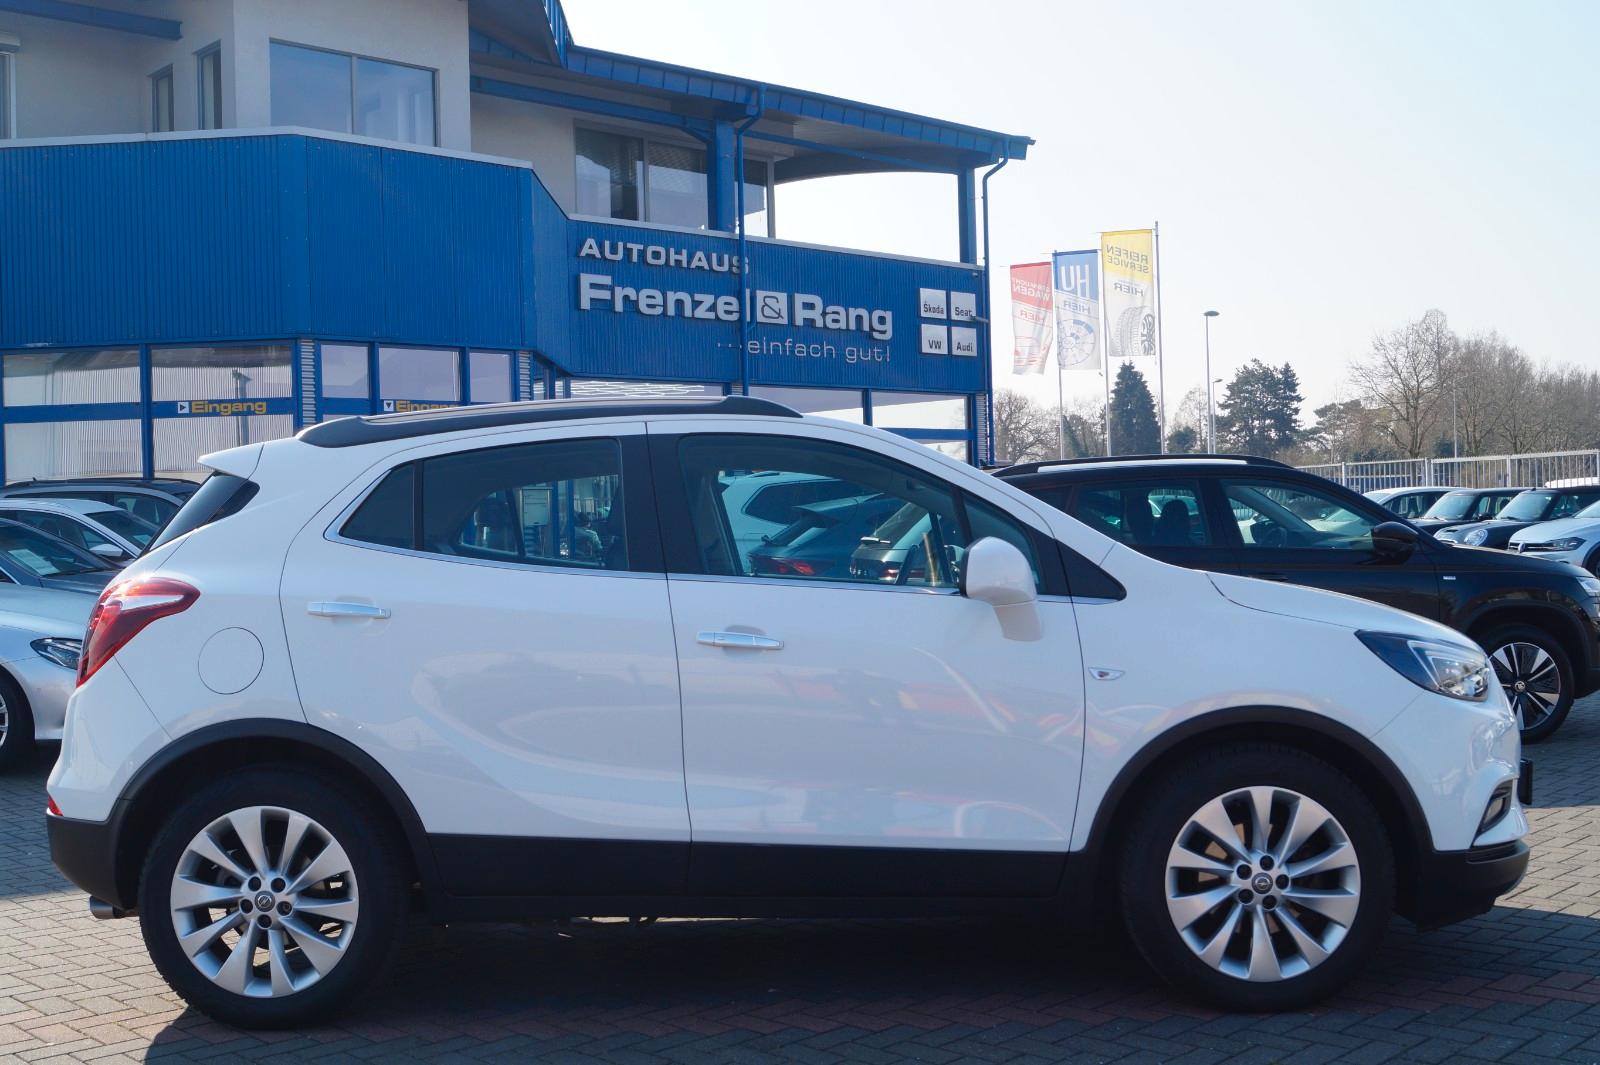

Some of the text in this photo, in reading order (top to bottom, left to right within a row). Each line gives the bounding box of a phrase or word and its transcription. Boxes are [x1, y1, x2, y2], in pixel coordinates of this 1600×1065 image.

[580, 237, 749, 275] AUTOHAUS
[759, 294, 786, 321] &
[794, 292, 893, 341] Rang
[954, 306, 973, 317] Seat
[928, 340, 942, 350] VW
[956, 342, 973, 353] Audi
[844, 344, 891, 365] gut!
[191, 400, 267, 416] Eingang
